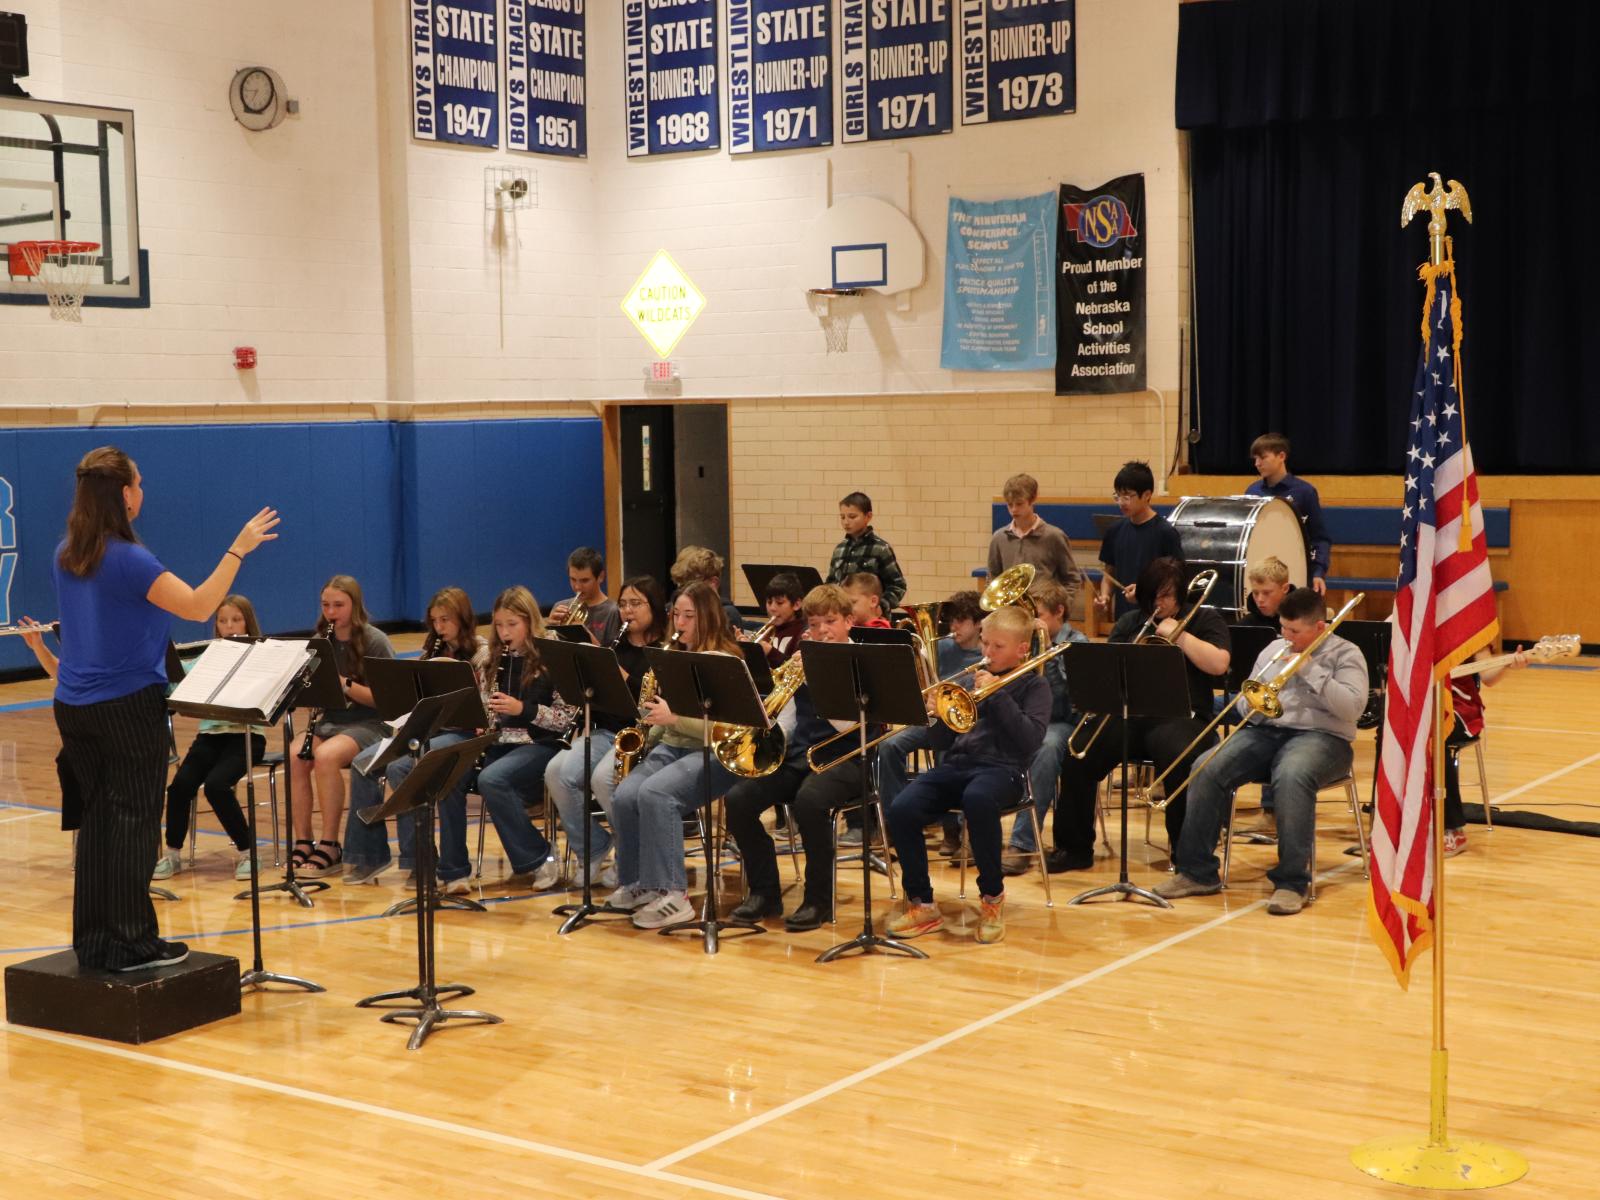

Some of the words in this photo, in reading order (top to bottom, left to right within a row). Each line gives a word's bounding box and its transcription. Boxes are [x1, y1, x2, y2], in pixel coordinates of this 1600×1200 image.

[436, 5, 495, 45] STATE
[756, 5, 826, 45] STATE
[844, 0, 863, 55] TRA
[871, 0, 946, 30] STATE
[529, 22, 583, 60] STATE
[650, 18, 713, 56] STATE
[990, 20, 1072, 63] RUNNER-UP
[436, 54, 496, 92] CHAMPION
[626, 2, 646, 151] WRESTLING
[756, 56, 828, 94] RUNNER-UP
[870, 40, 948, 81] RUNNER-UP
[964, 0, 985, 118] WRESTL
[416, 64, 433, 134] BOYS
[530, 68, 584, 105] CHAMPION
[650, 64, 715, 102] RUNNER-UP
[846, 62, 864, 136] GIRLS
[998, 72, 1064, 112] 1973
[443, 103, 492, 138] 1947
[510, 79, 526, 144] BOYS
[656, 112, 710, 146] 1968
[762, 106, 818, 142] 1971
[878, 92, 936, 131] 1971
[536, 115, 577, 149] 1951
[1062, 260, 1092, 274] Proud
[1096, 256, 1142, 274] Member
[640, 286, 687, 302] CAUTION
[1087, 282, 1098, 294] of
[1100, 280, 1118, 292] the
[638, 306, 691, 322] WILDCATS
[1076, 300, 1130, 315] Nebraska
[1083, 321, 1124, 335] School
[1078, 342, 1130, 356] Activities
[1071, 363, 1136, 377] Association
